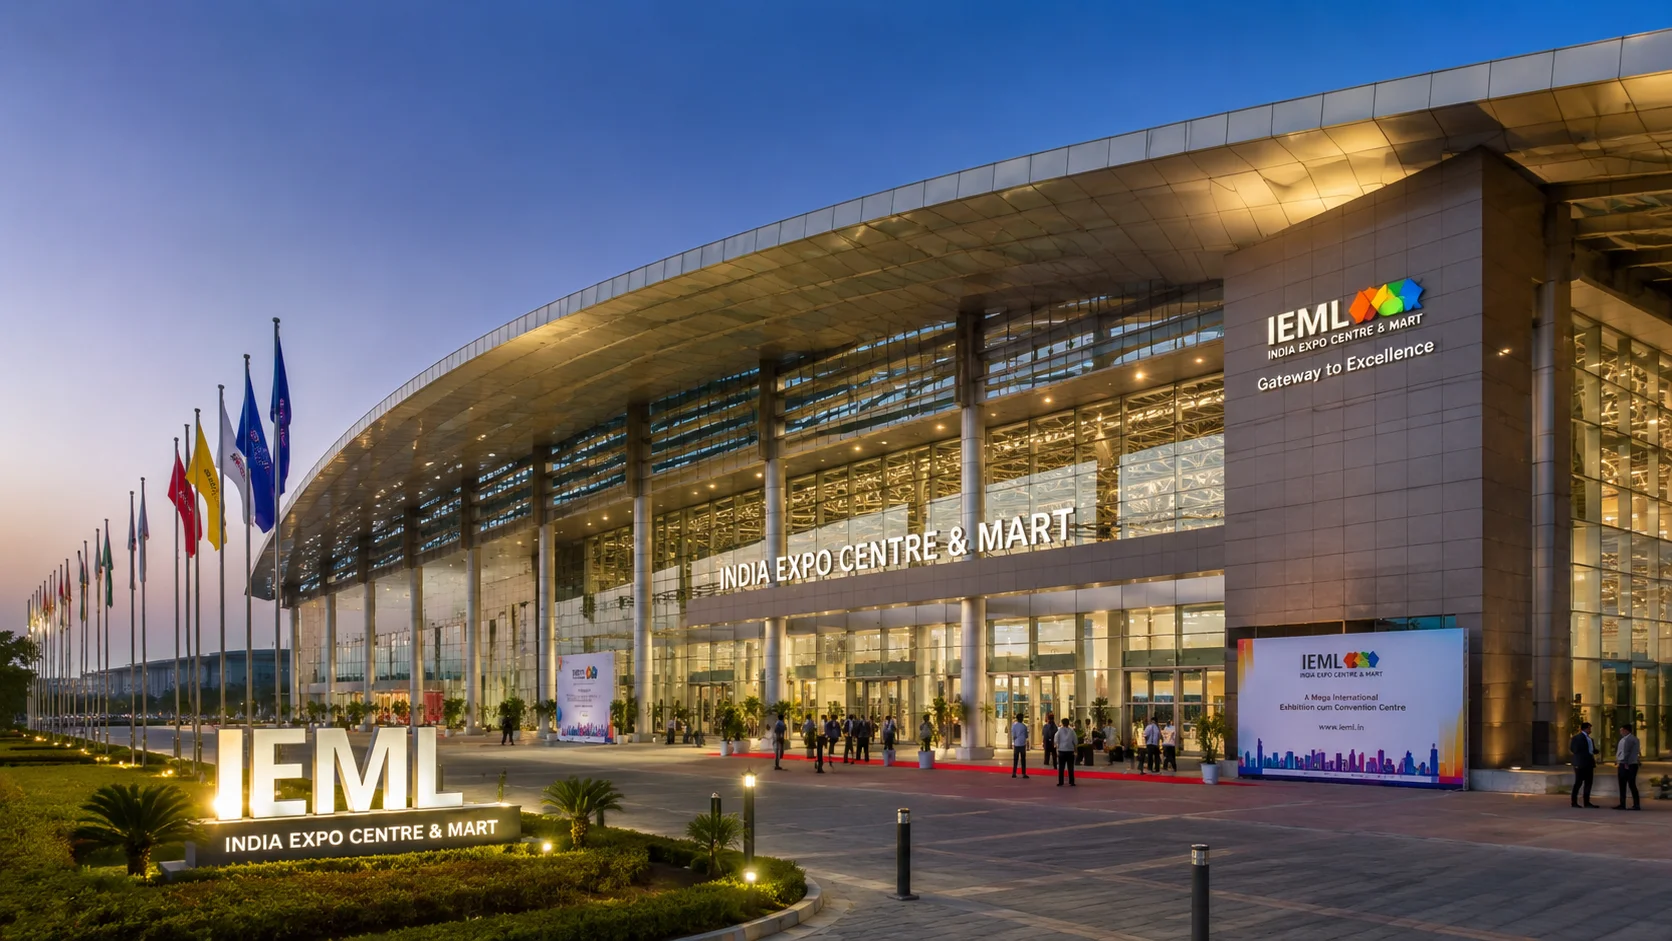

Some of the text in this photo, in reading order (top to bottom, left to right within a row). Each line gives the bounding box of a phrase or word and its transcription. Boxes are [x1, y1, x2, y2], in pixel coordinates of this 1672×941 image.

[1267, 299, 1349, 346] IEML
[1267, 313, 1423, 360] INDIA EXPO CENTRE & MART
[1257, 340, 1435, 391] Gateway to Excellence
[719, 507, 1075, 590] INDIA EXPO CENTRE & MART
[1302, 653, 1343, 670] IEML
[1334, 703, 1377, 711] Convention
[1379, 703, 1406, 711] Centre
[215, 726, 464, 821] IEML
[225, 819, 499, 853] INDIA EXPO CENTRE & MART
